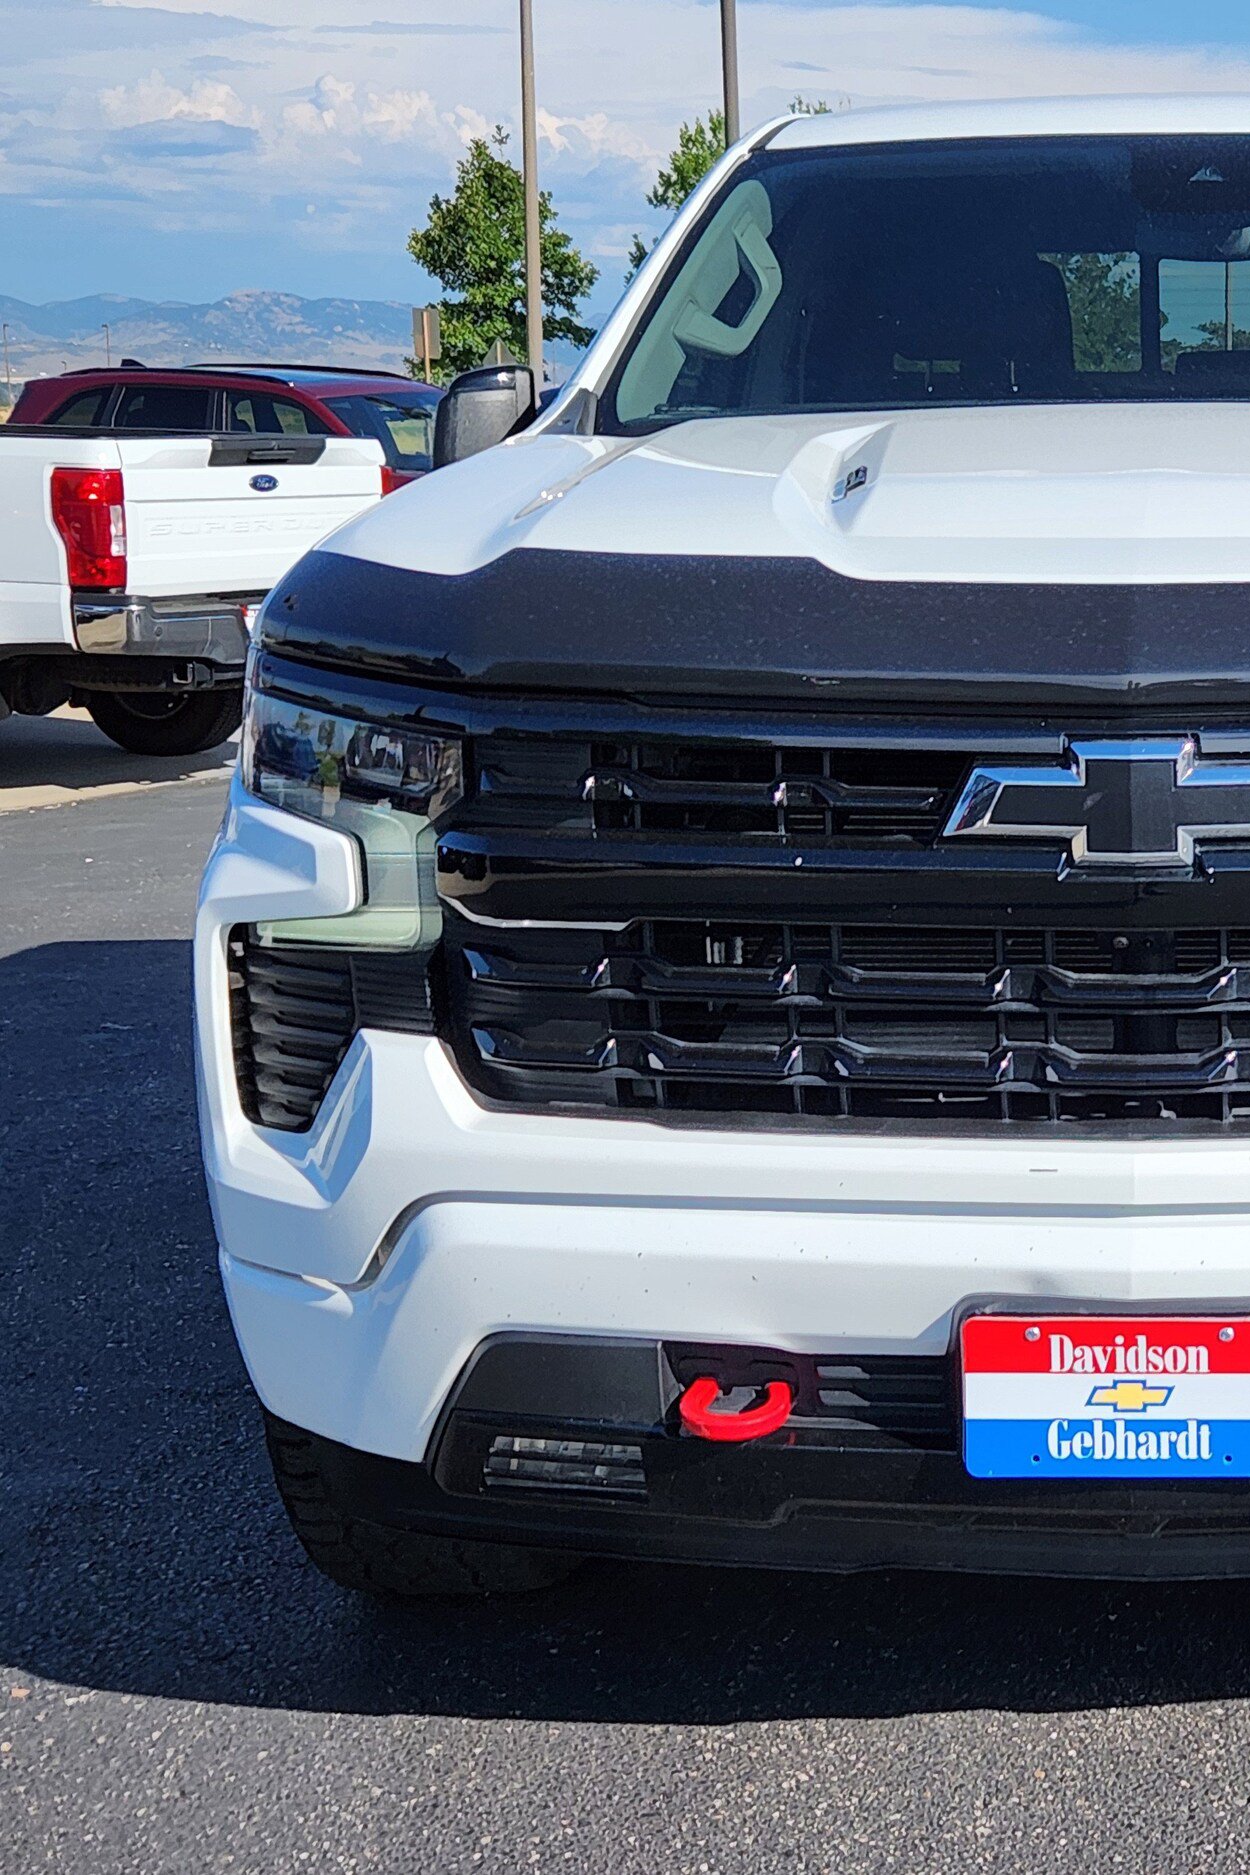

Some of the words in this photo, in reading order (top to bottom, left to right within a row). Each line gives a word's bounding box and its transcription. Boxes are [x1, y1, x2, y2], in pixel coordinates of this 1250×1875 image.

[150, 520, 272, 537] SUPER
[1048, 1334, 1210, 1374] Davidson
[1047, 1419, 1213, 1461] Gebhardt
